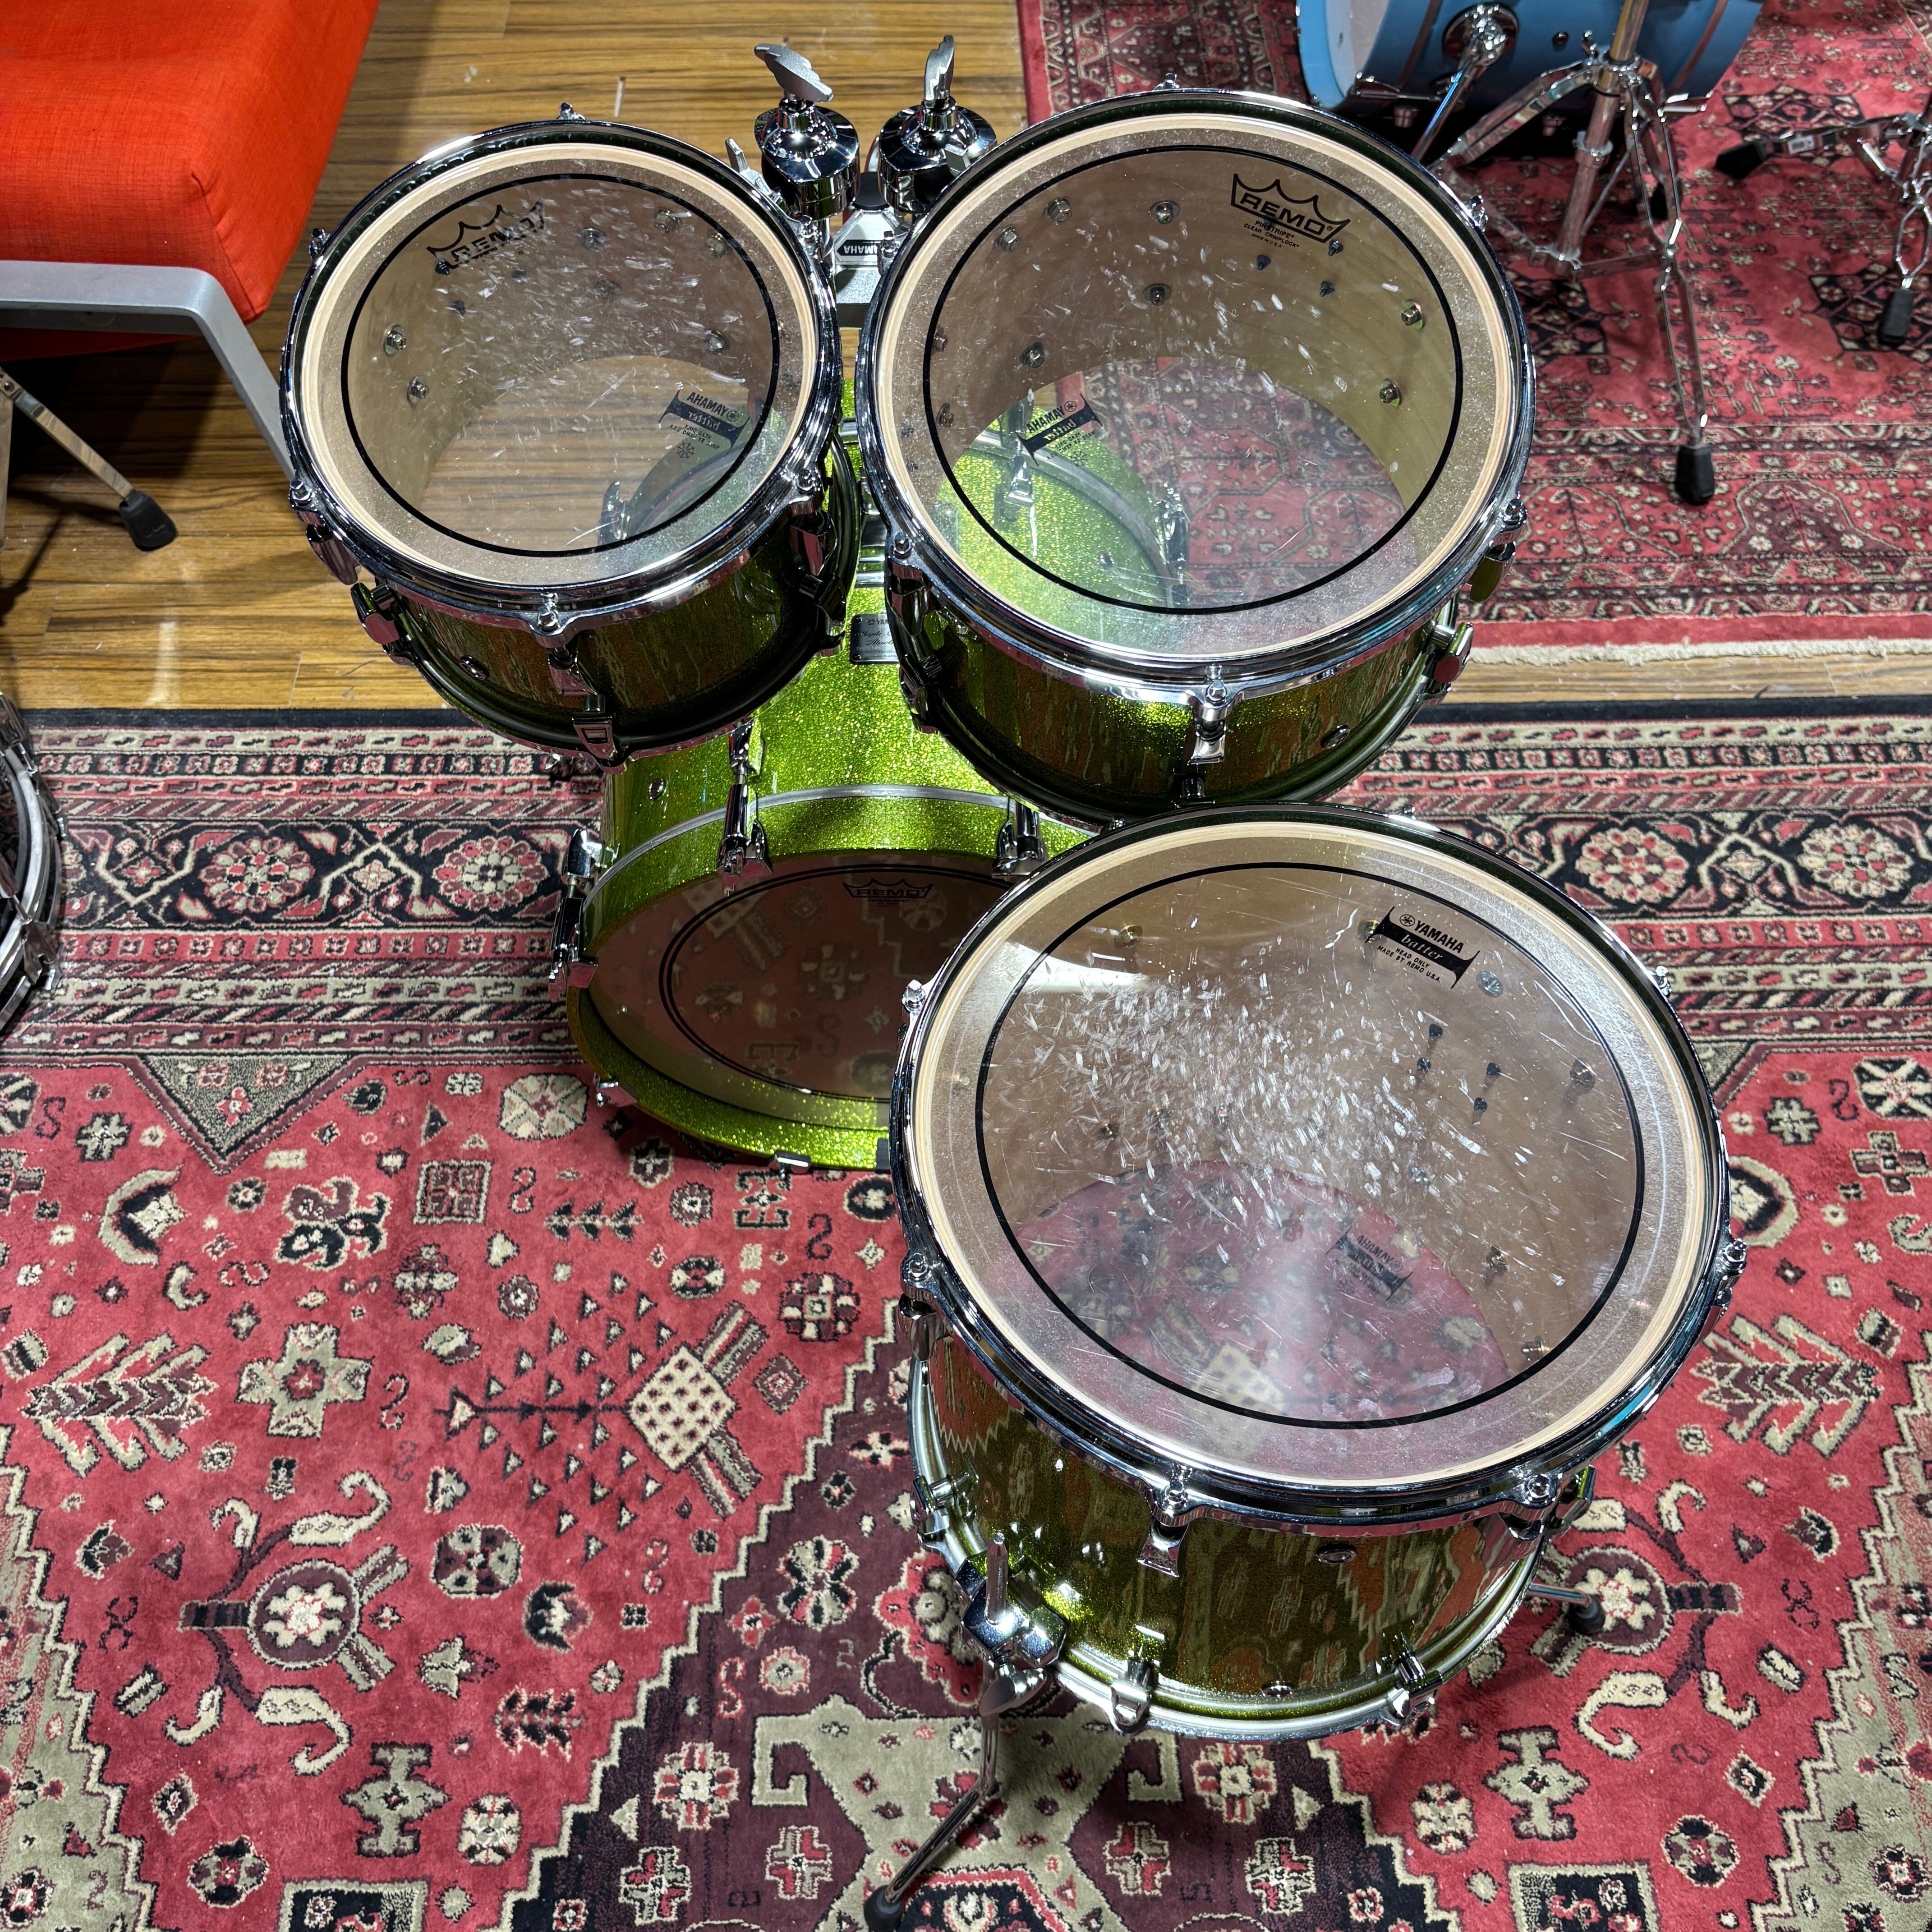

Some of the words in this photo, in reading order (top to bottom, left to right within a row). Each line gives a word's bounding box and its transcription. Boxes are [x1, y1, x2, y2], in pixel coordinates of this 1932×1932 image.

[1240, 193, 1325, 235] REMO
[843, 245, 878, 254] AMAHA
[1401, 934, 1443, 960] batter
[1414, 920, 1464, 953] YAMAHA
[1377, 945, 1394, 957] MADE
[1407, 961, 1424, 973] REMO
[1426, 972, 1441, 983] U.S.A.
[1395, 948, 1412, 959] HEAD
[1414, 957, 1430, 968] ONLY
